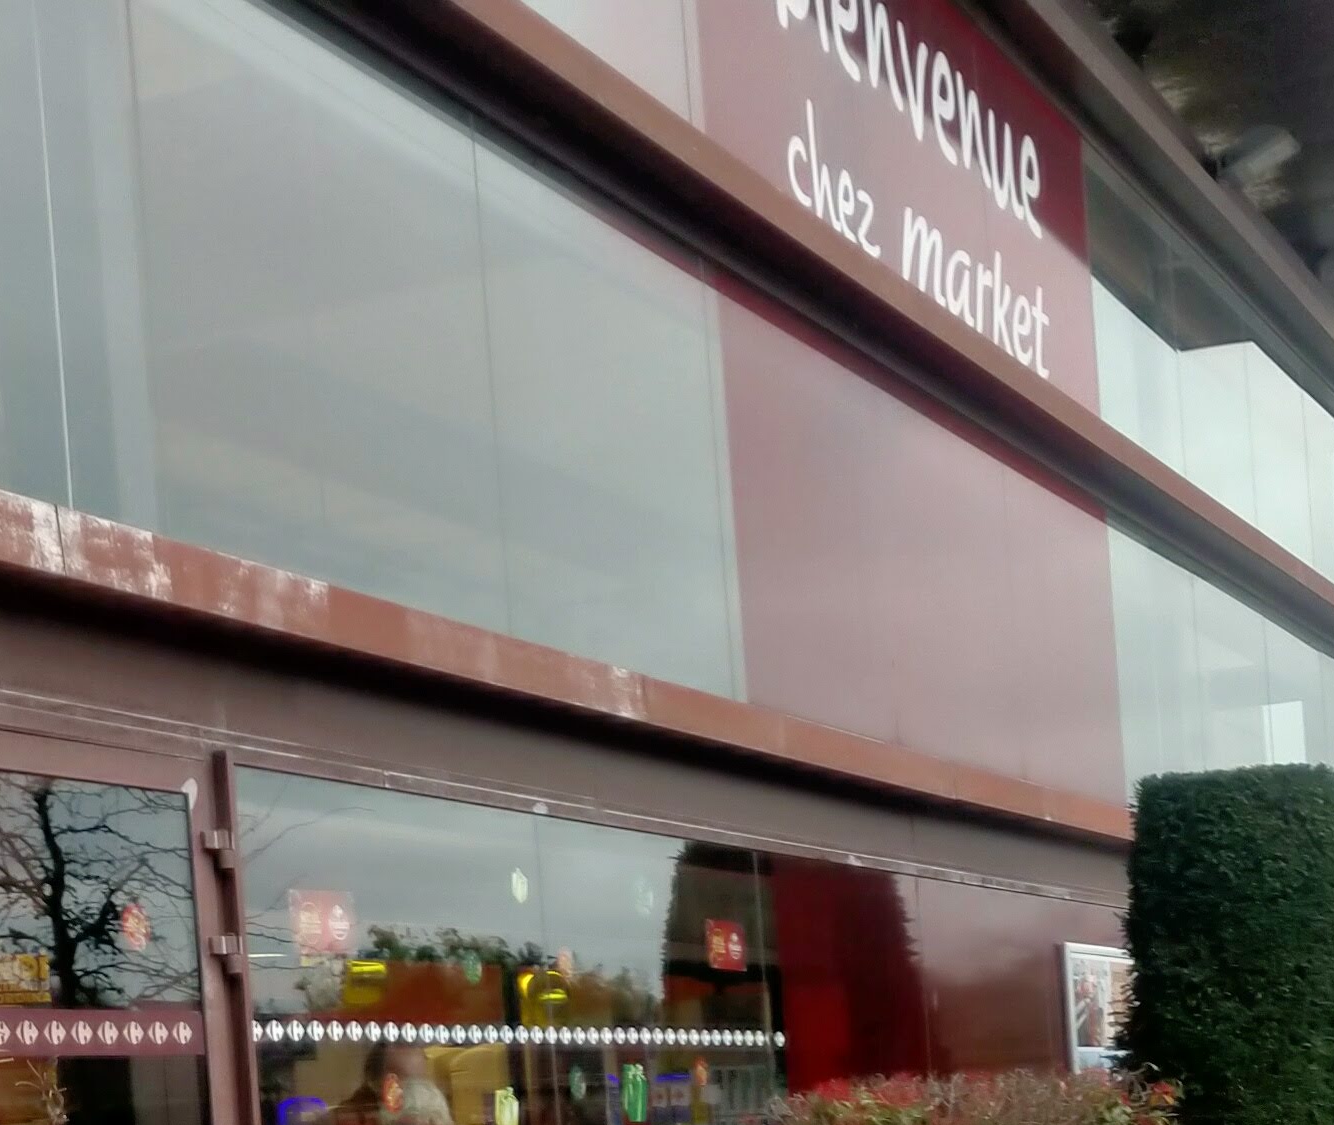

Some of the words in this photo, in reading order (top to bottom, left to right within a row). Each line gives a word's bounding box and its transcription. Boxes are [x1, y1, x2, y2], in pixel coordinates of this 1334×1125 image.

[777, 0, 1043, 238] ienvenue
[788, 99, 880, 258] chez
[902, 207, 1049, 379] market
